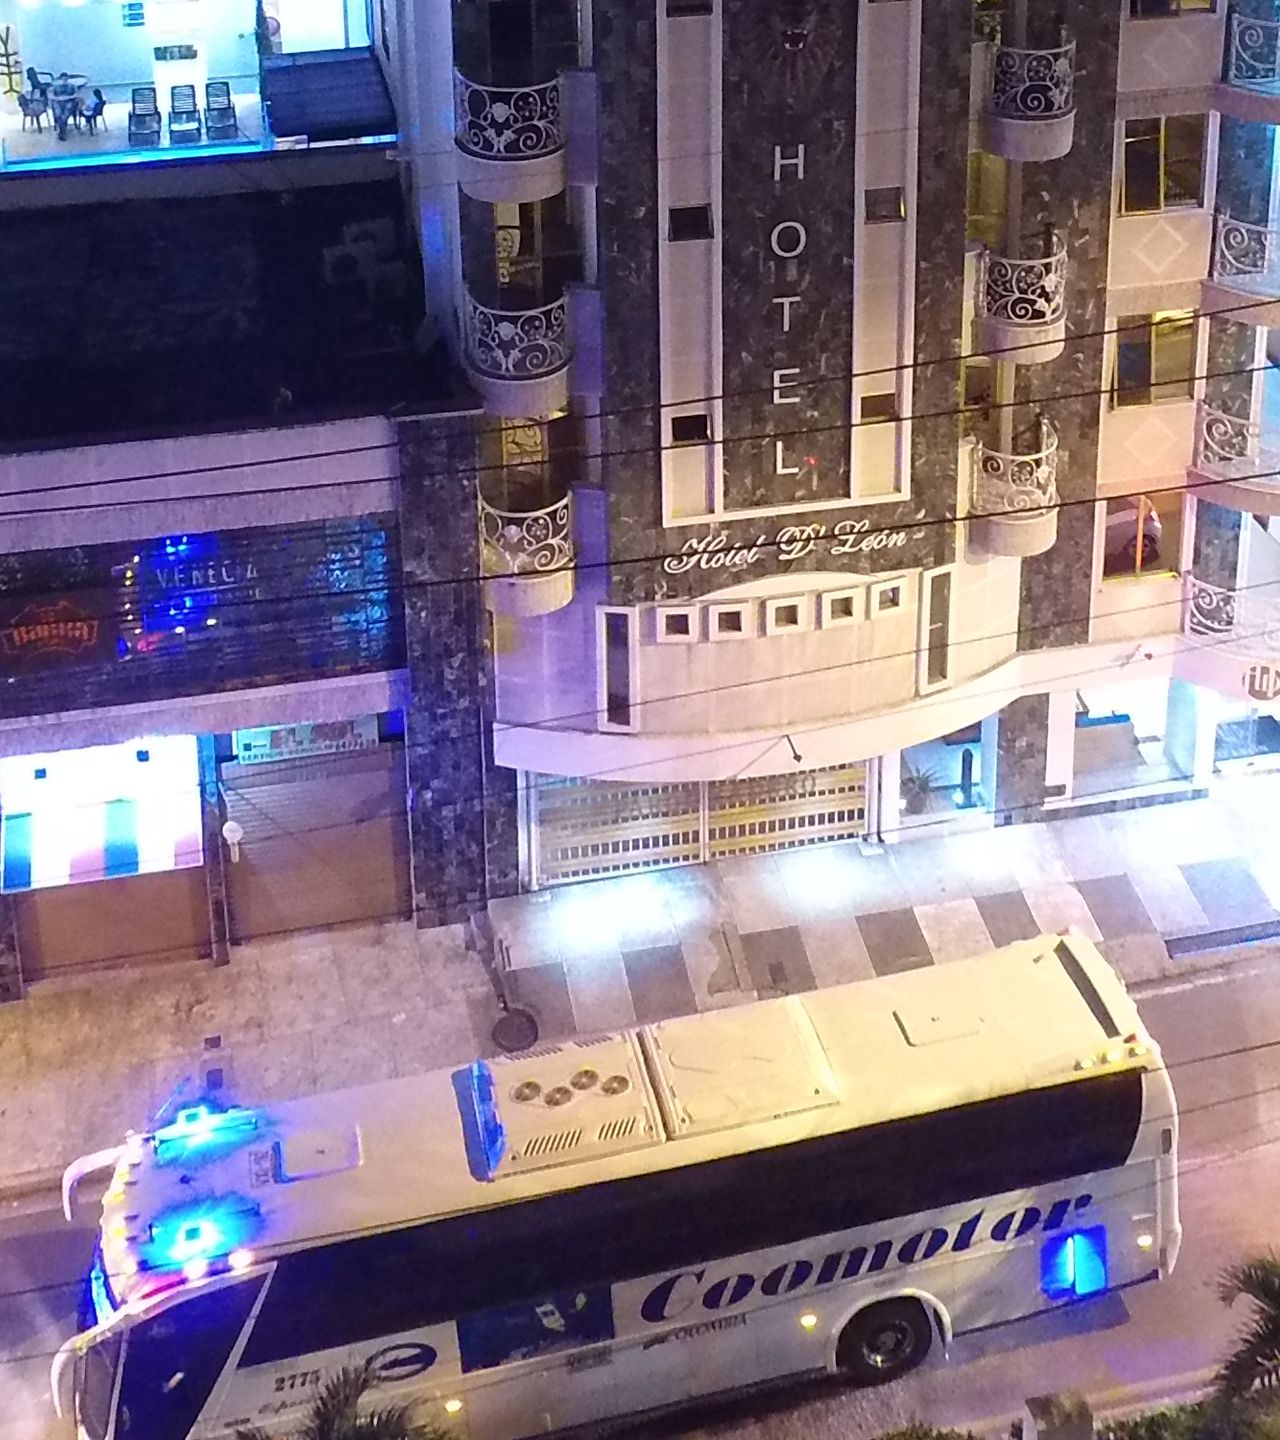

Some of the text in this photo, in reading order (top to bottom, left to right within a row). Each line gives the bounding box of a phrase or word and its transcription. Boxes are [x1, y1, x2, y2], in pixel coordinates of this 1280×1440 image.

[770, 142, 808, 477] HOTEL
[663, 534, 767, 574] Hotel
[640, 1193, 1093, 1323] Coomotor
